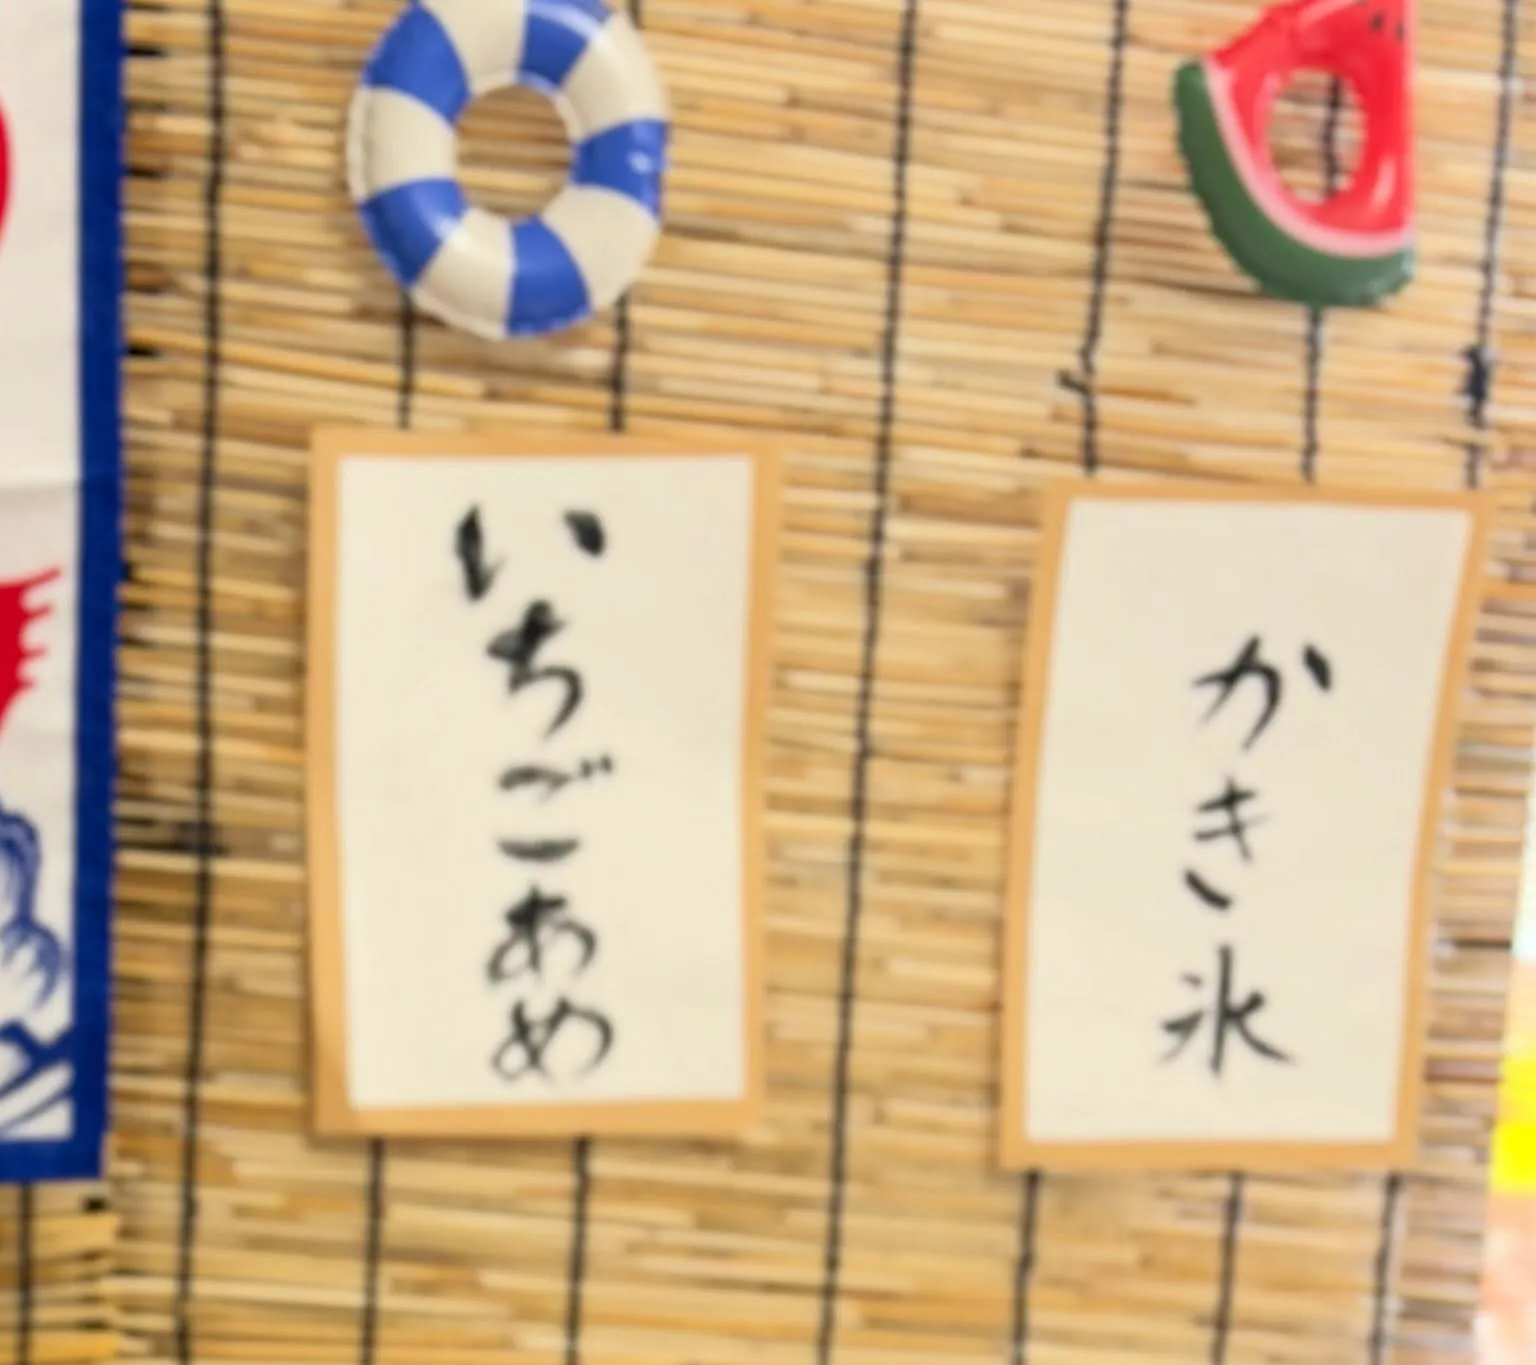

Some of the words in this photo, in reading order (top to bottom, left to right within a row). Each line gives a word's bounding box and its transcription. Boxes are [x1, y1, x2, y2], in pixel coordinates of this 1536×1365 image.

[452, 504, 616, 1086] いちごあめ
[1156, 634, 1336, 1080] かき氷
